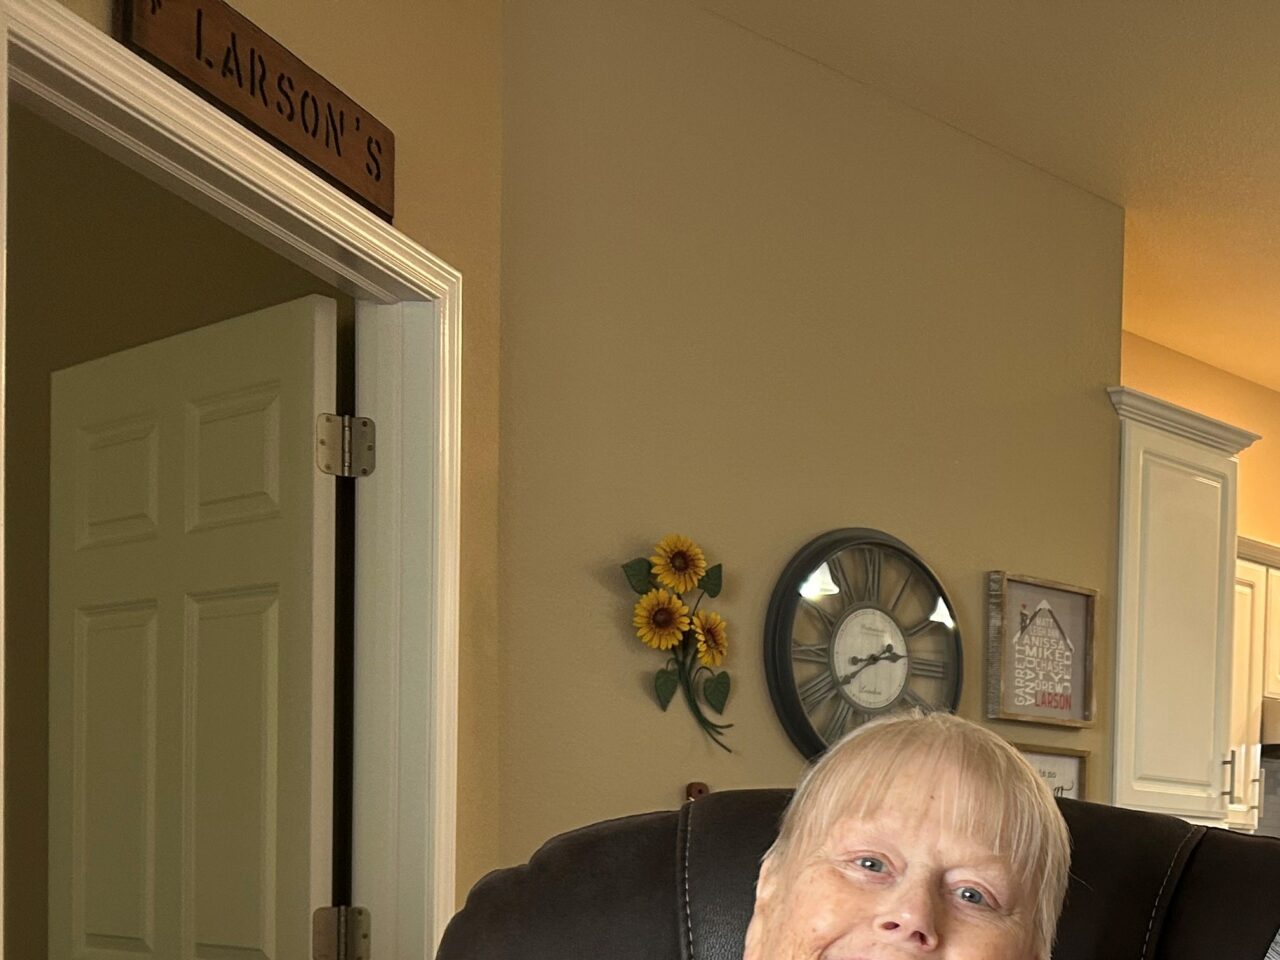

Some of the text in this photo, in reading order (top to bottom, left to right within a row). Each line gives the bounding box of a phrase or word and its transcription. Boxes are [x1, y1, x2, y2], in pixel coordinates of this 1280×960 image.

[195, 8, 382, 182] LARSON'S
[1023, 635, 1065, 650] ANISSA
[1025, 645, 1064, 661] MIKE
[1015, 645, 1025, 705] GARRETT
[1025, 657, 1036, 705] DANA
[1035, 680, 1064, 693] DREW
[1035, 690, 1072, 711] LARSON
